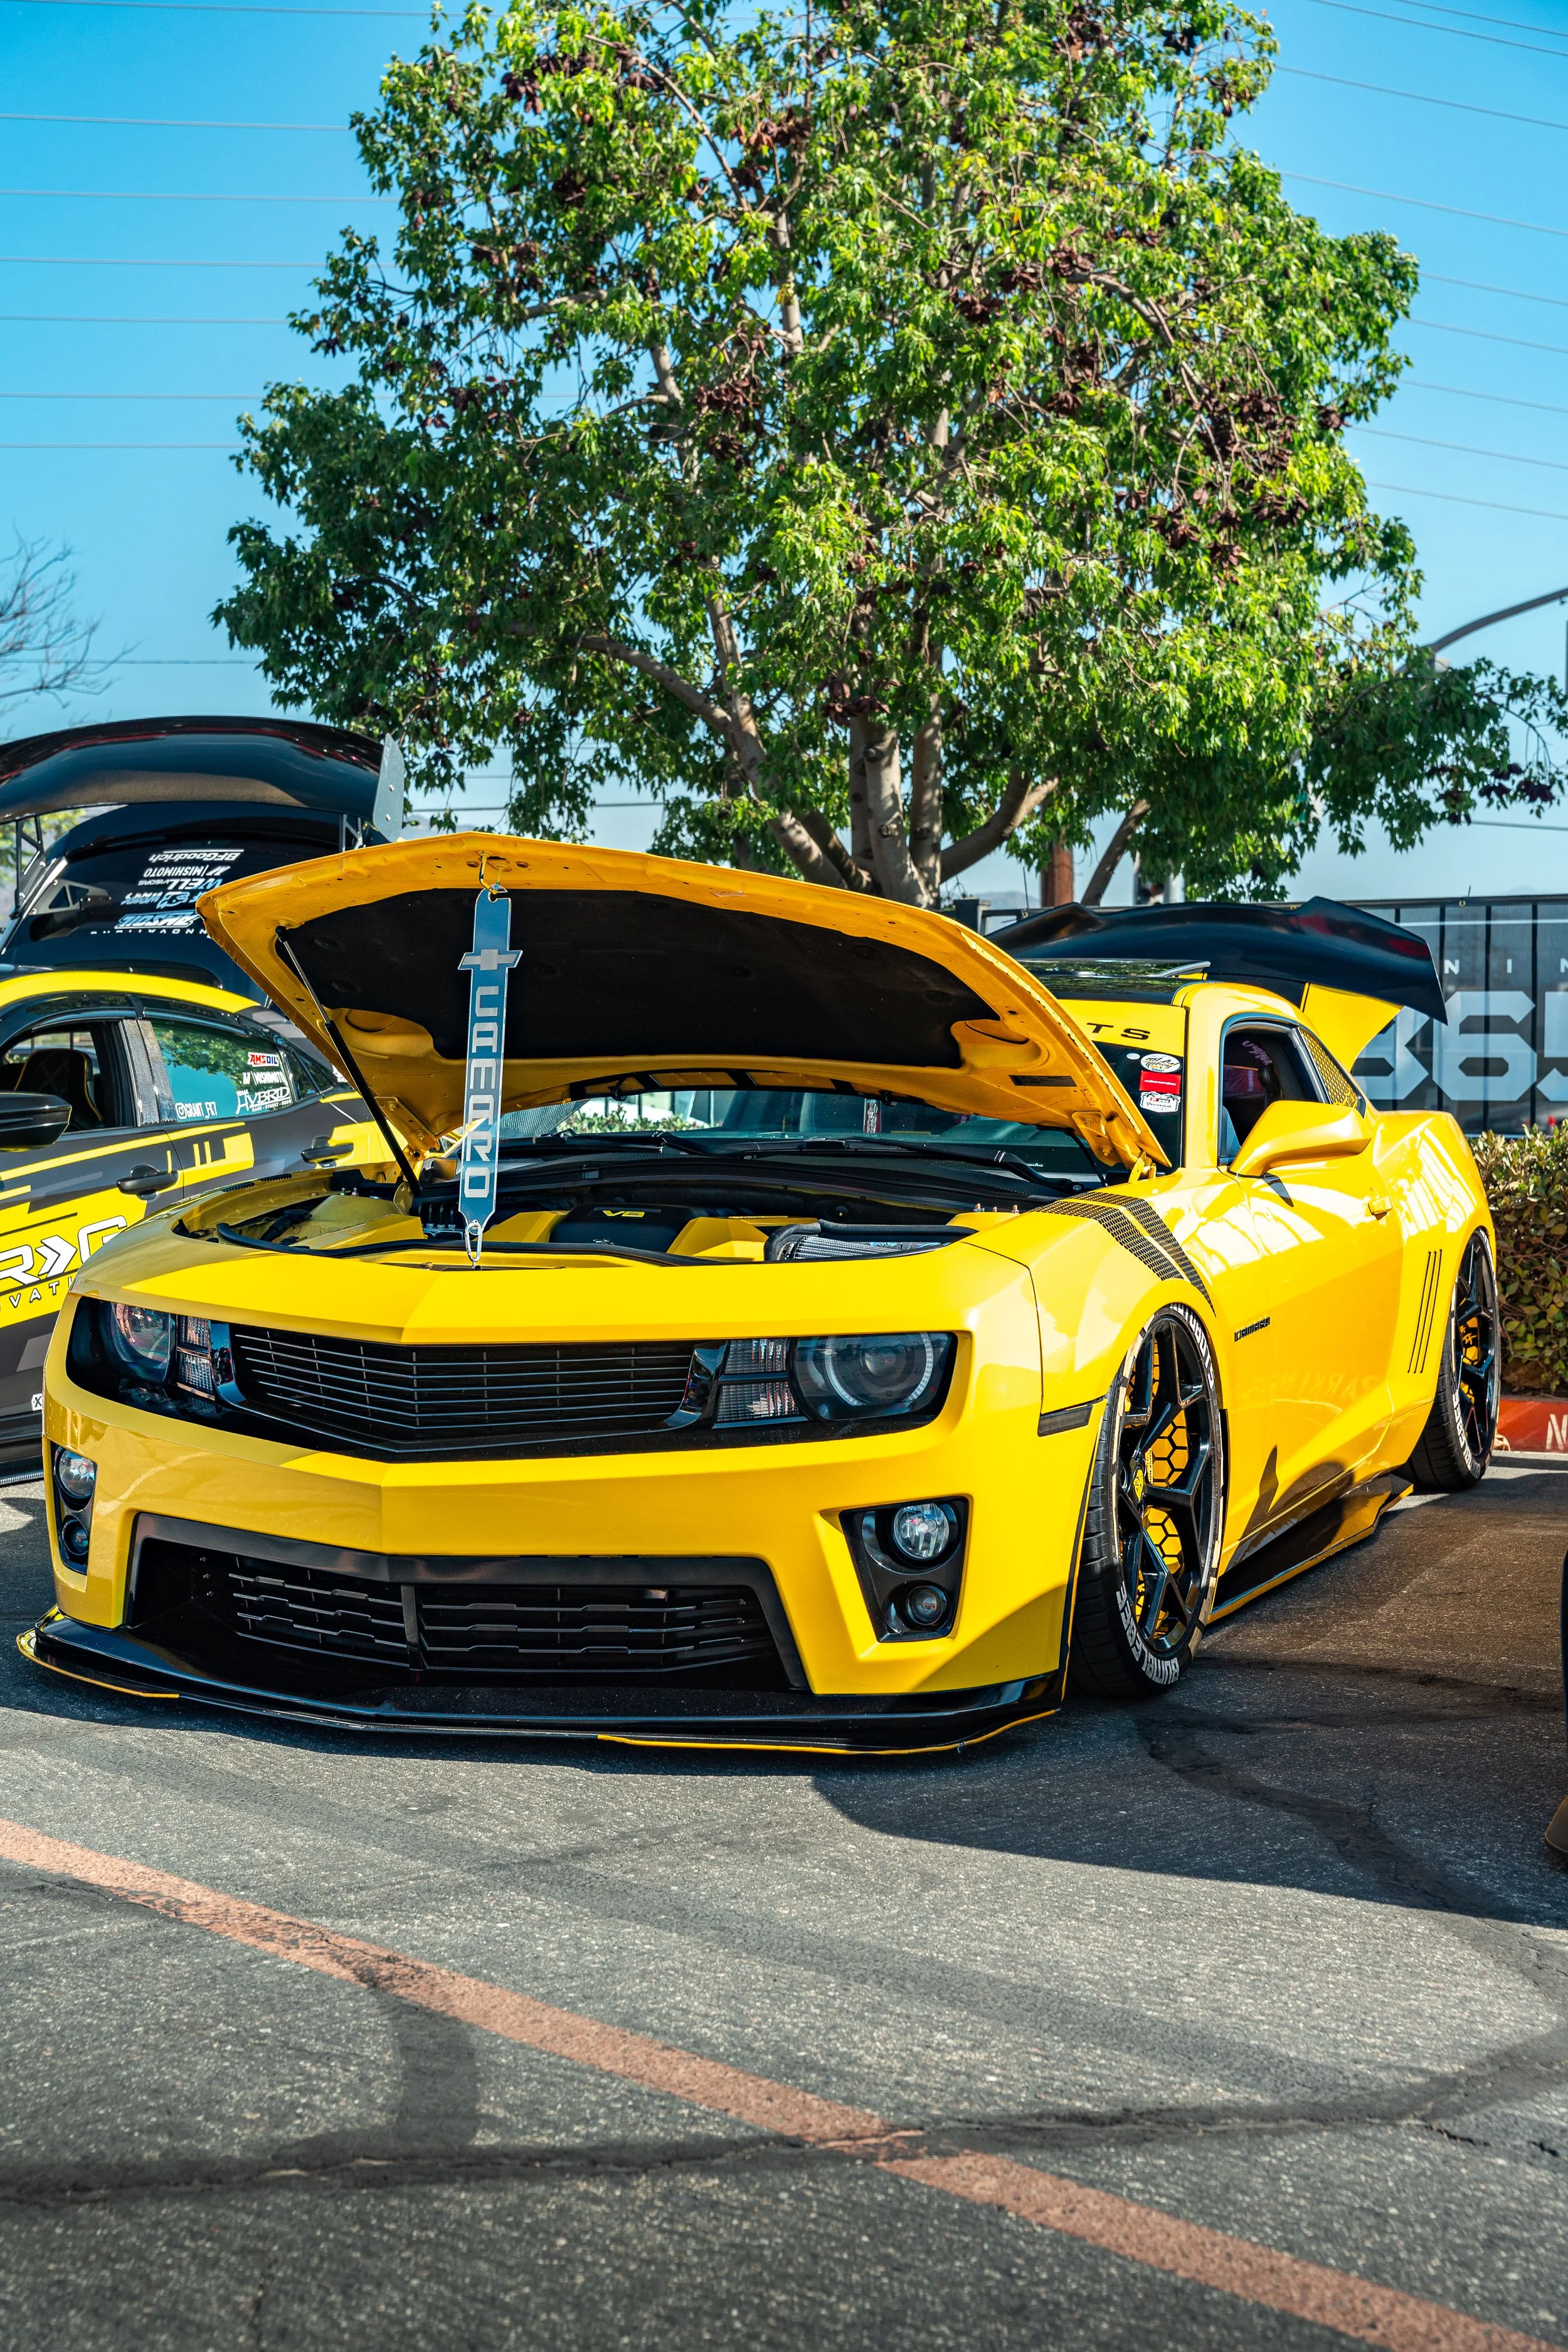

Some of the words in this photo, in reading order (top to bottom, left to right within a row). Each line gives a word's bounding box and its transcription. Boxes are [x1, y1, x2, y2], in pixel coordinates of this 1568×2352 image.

[148, 852, 241, 863] BFGoodrich
[143, 866, 204, 877] MISHIMOTO
[118, 913, 194, 927] AMSOIL
[250, 1054, 278, 1065] AMSOIL
[464, 985, 499, 1199] CAMARO
[603, 1210, 645, 1218] V8
[1116, 1580, 1180, 1685] BUMBLEBEE
